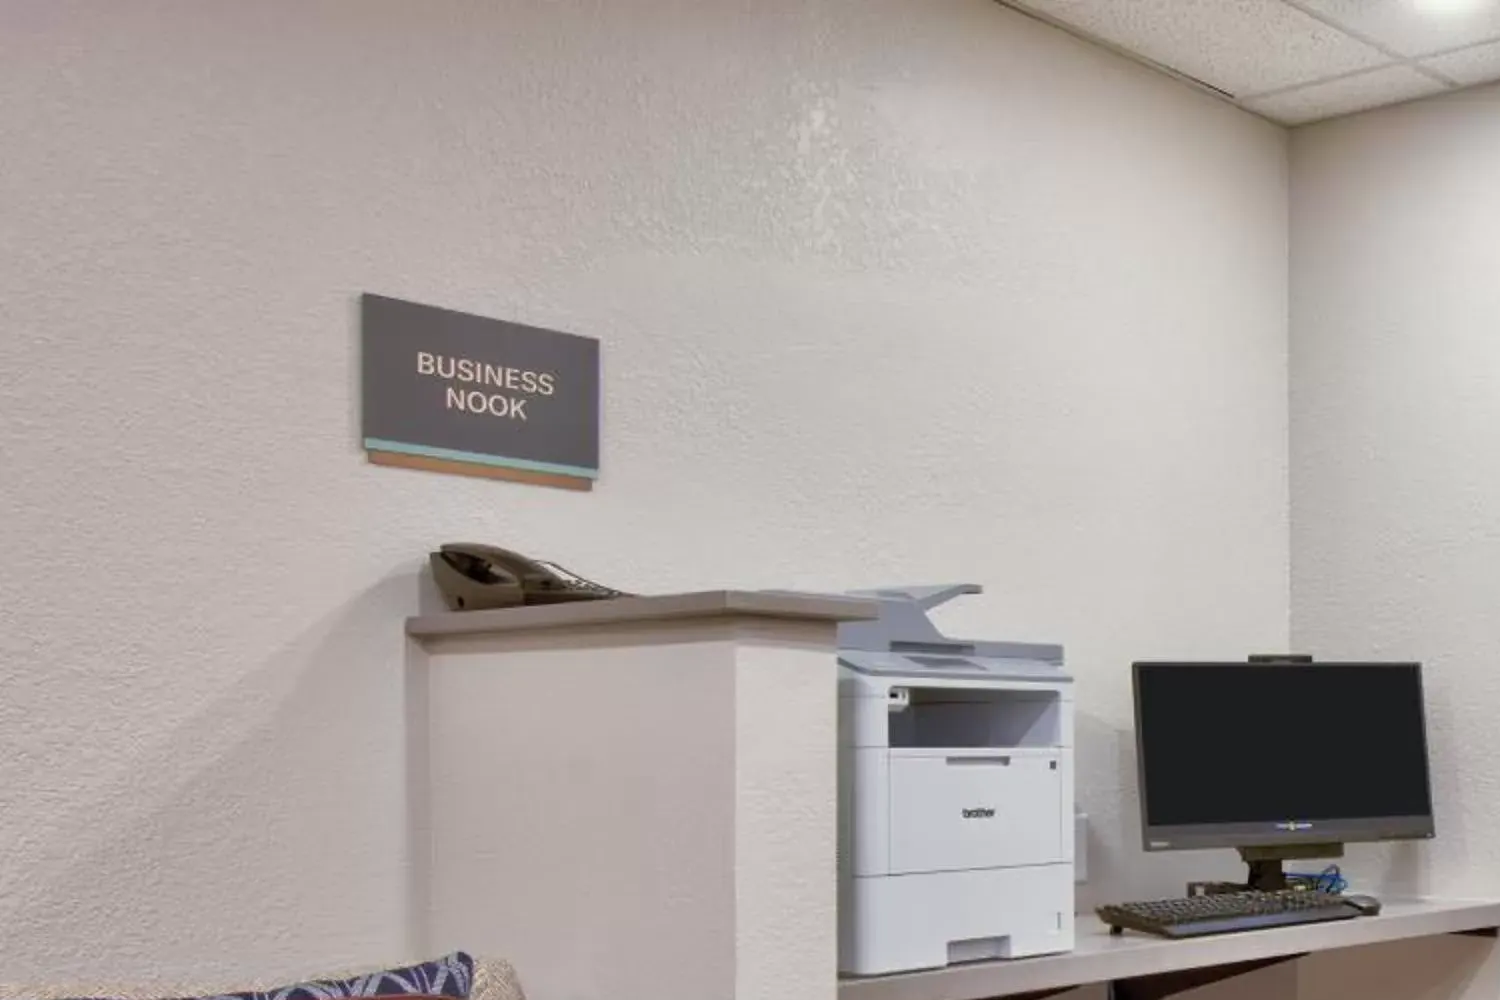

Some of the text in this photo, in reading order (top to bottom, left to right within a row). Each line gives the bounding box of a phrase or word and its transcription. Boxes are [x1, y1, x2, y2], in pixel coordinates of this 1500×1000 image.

[416, 351, 555, 396] BUSINESS
[446, 386, 528, 421] NOOK
[962, 807, 995, 819] brother
